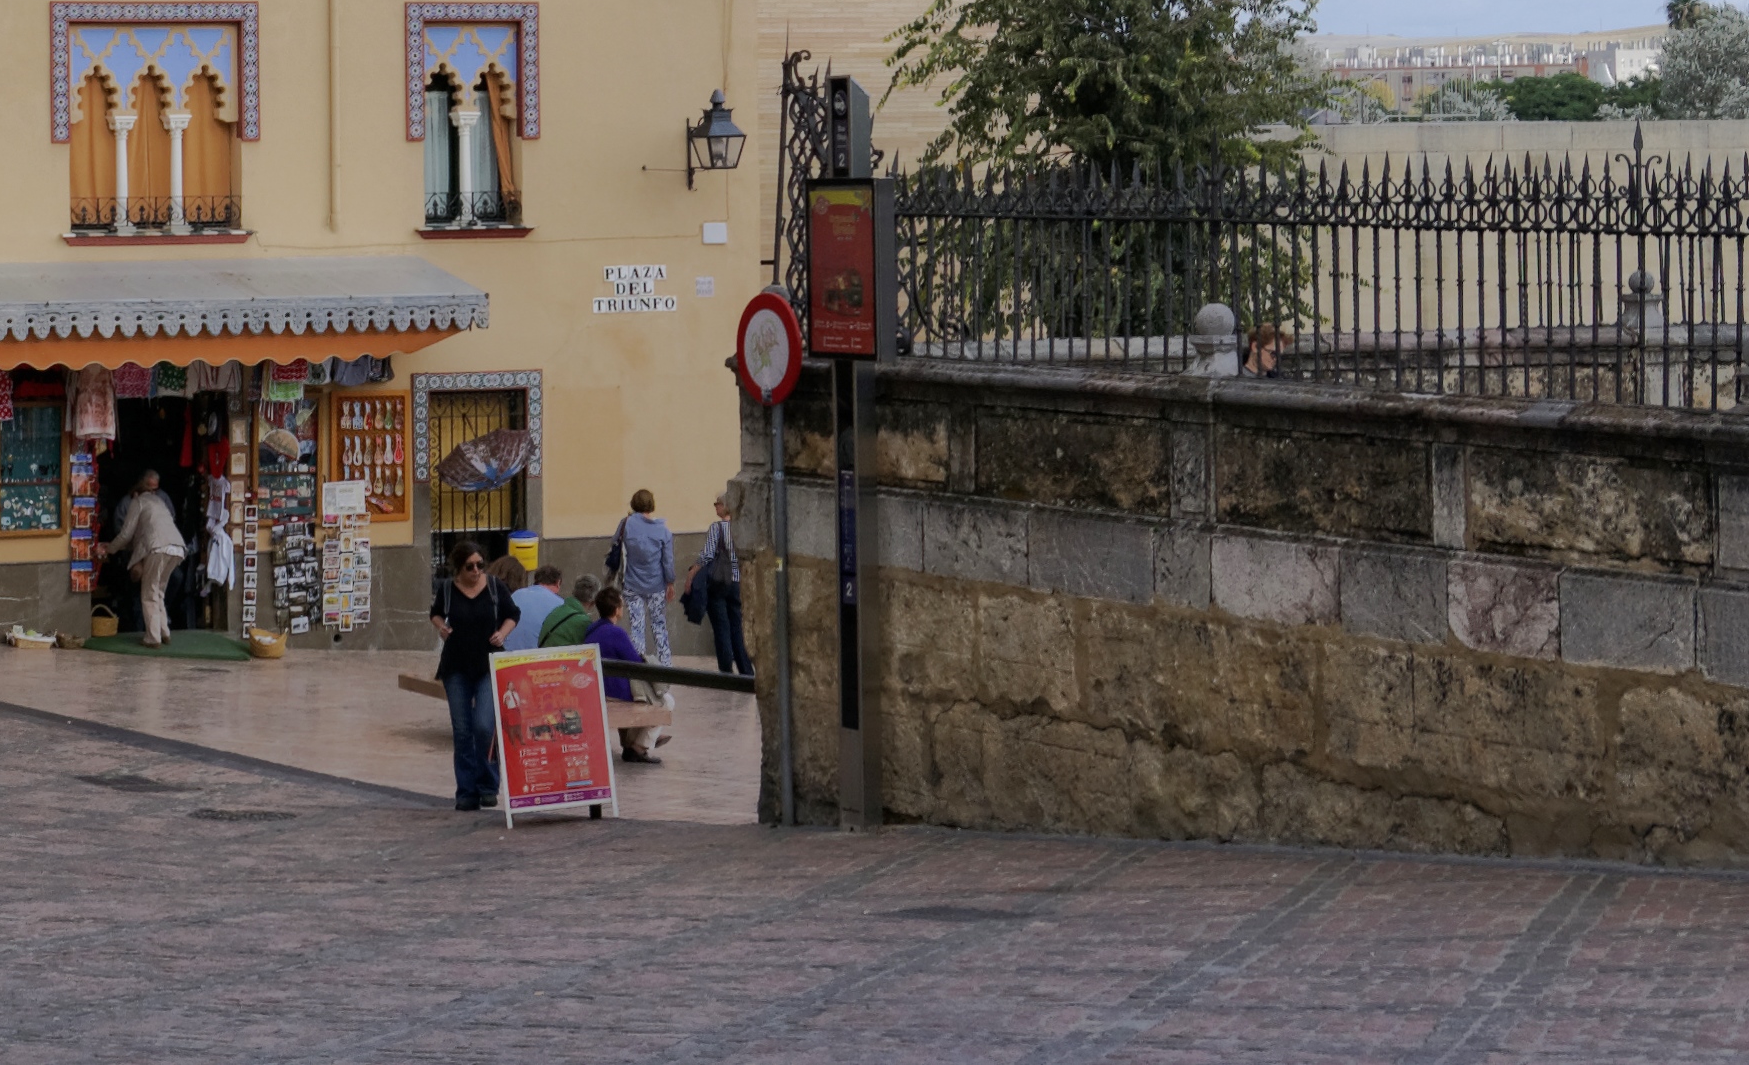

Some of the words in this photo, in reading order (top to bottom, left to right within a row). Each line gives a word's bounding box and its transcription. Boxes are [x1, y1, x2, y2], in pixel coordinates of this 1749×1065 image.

[838, 152, 845, 167] 2
[605, 267, 664, 280] PLAZA
[616, 282, 652, 295] DEL
[594, 298, 674, 311] TRIUNFO
[846, 582, 853, 596] 2
